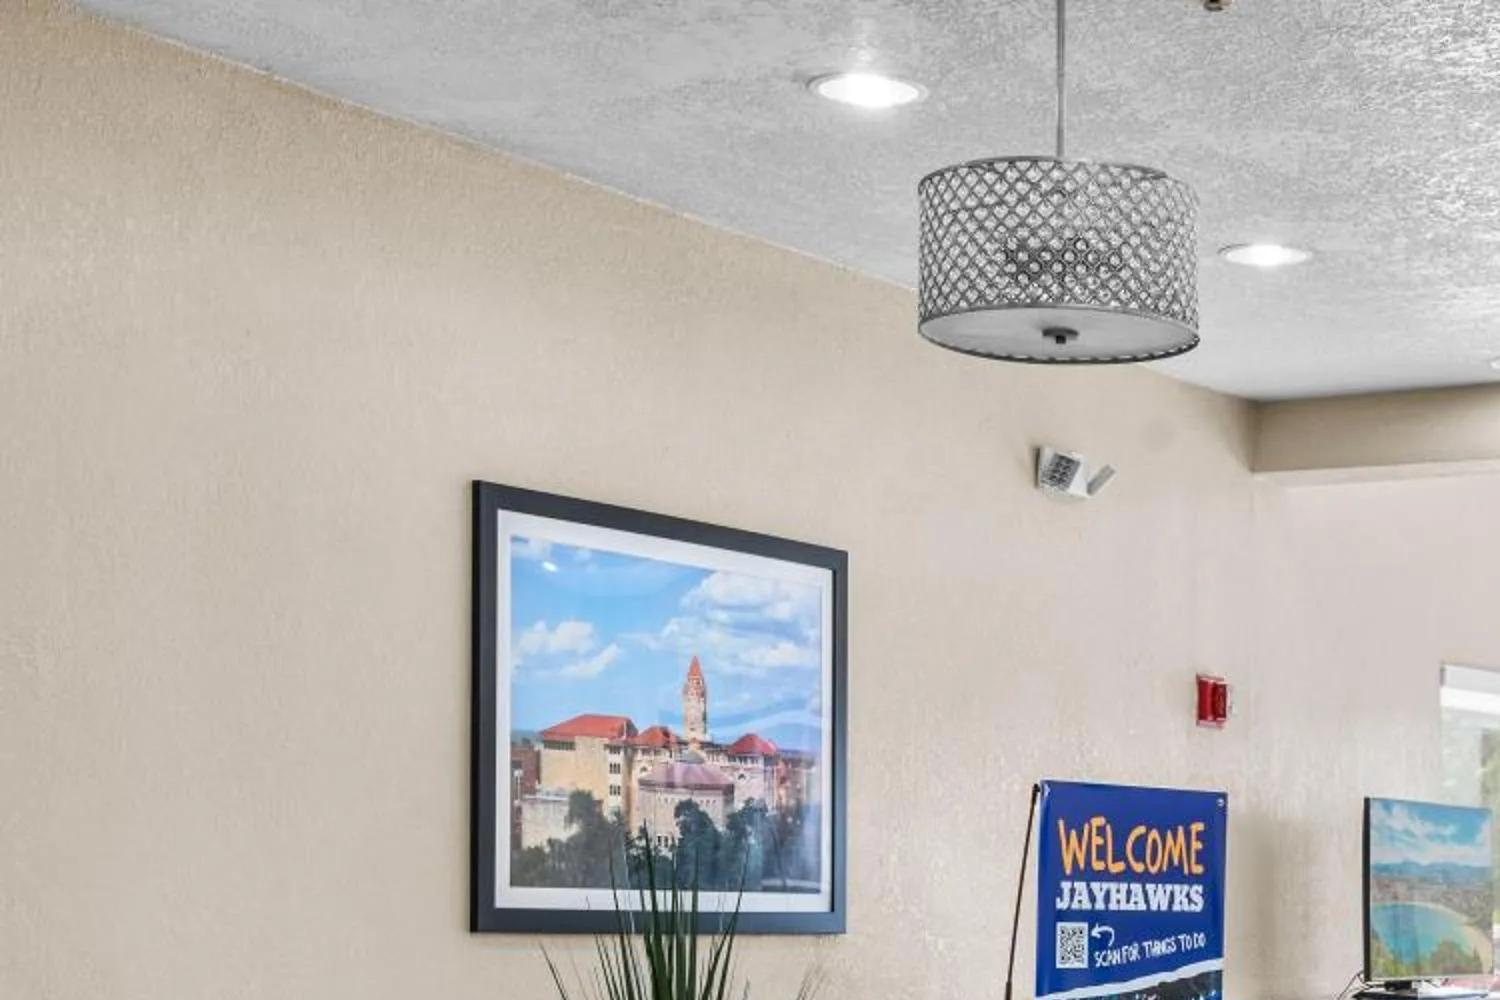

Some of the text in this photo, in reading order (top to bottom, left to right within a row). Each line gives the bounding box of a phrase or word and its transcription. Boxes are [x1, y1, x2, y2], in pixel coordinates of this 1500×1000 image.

[1058, 816, 1205, 876] WELCOME
[1056, 880, 1204, 912] JAYHAWKS
[1094, 932, 1206, 967] SCAN FOR THINGS TO DO
